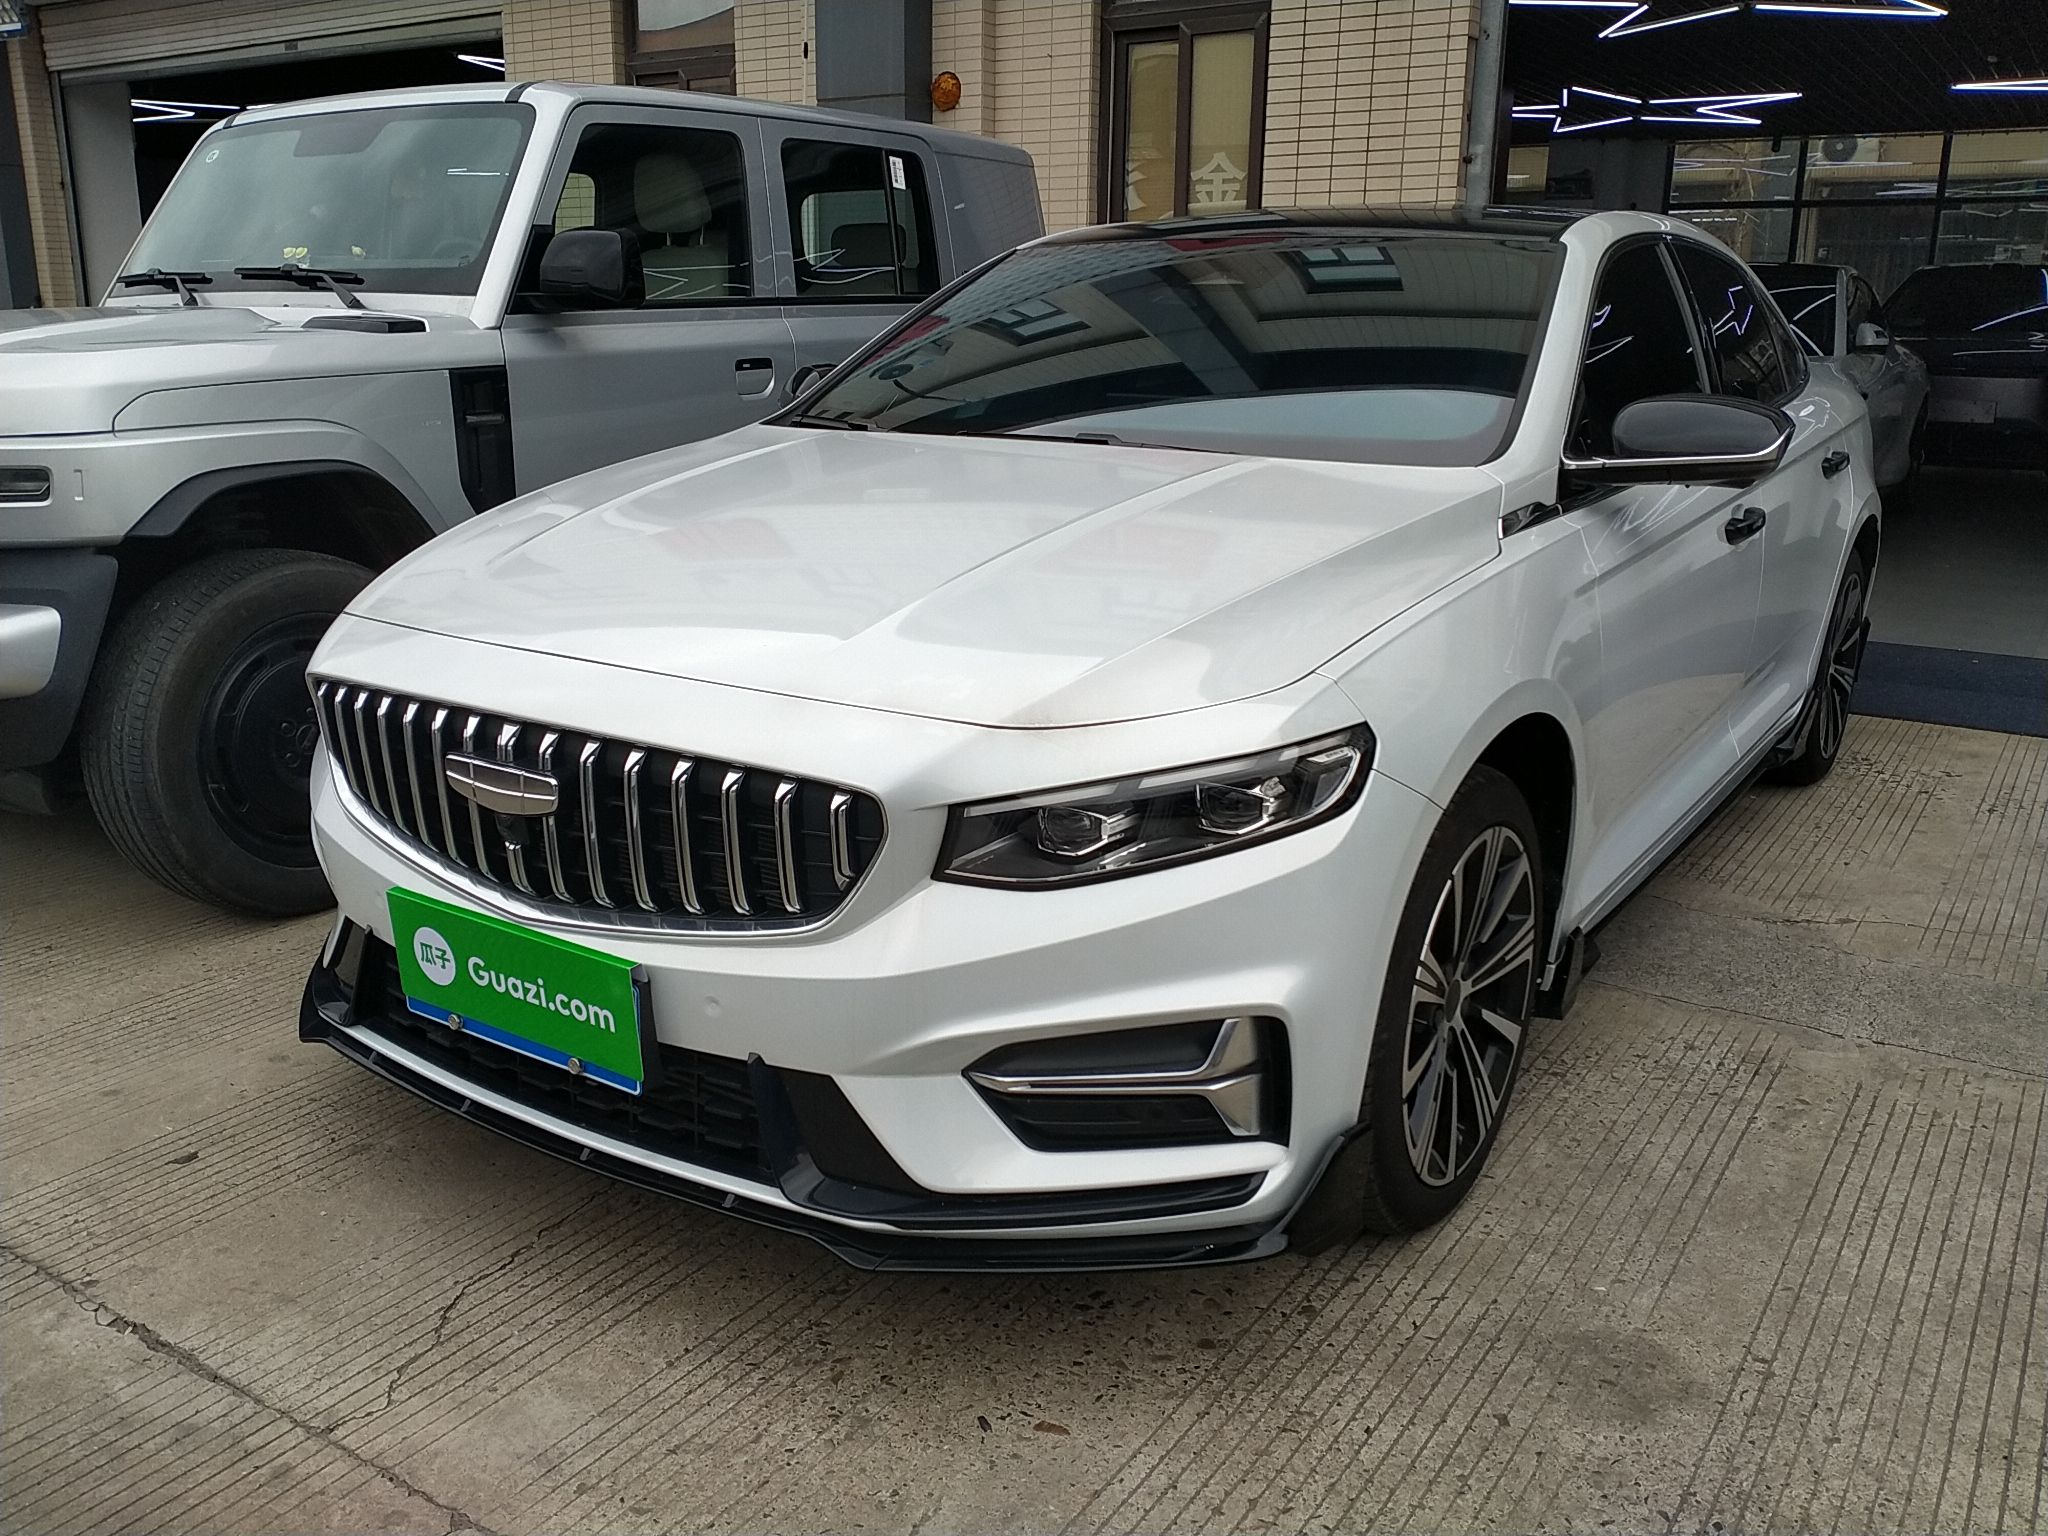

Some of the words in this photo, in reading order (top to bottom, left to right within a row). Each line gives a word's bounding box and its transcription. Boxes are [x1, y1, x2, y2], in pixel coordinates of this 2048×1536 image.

[1190, 151, 1247, 210] 金
[419, 941, 451, 969] 瓜子
[467, 956, 616, 1033] Guazi.com
